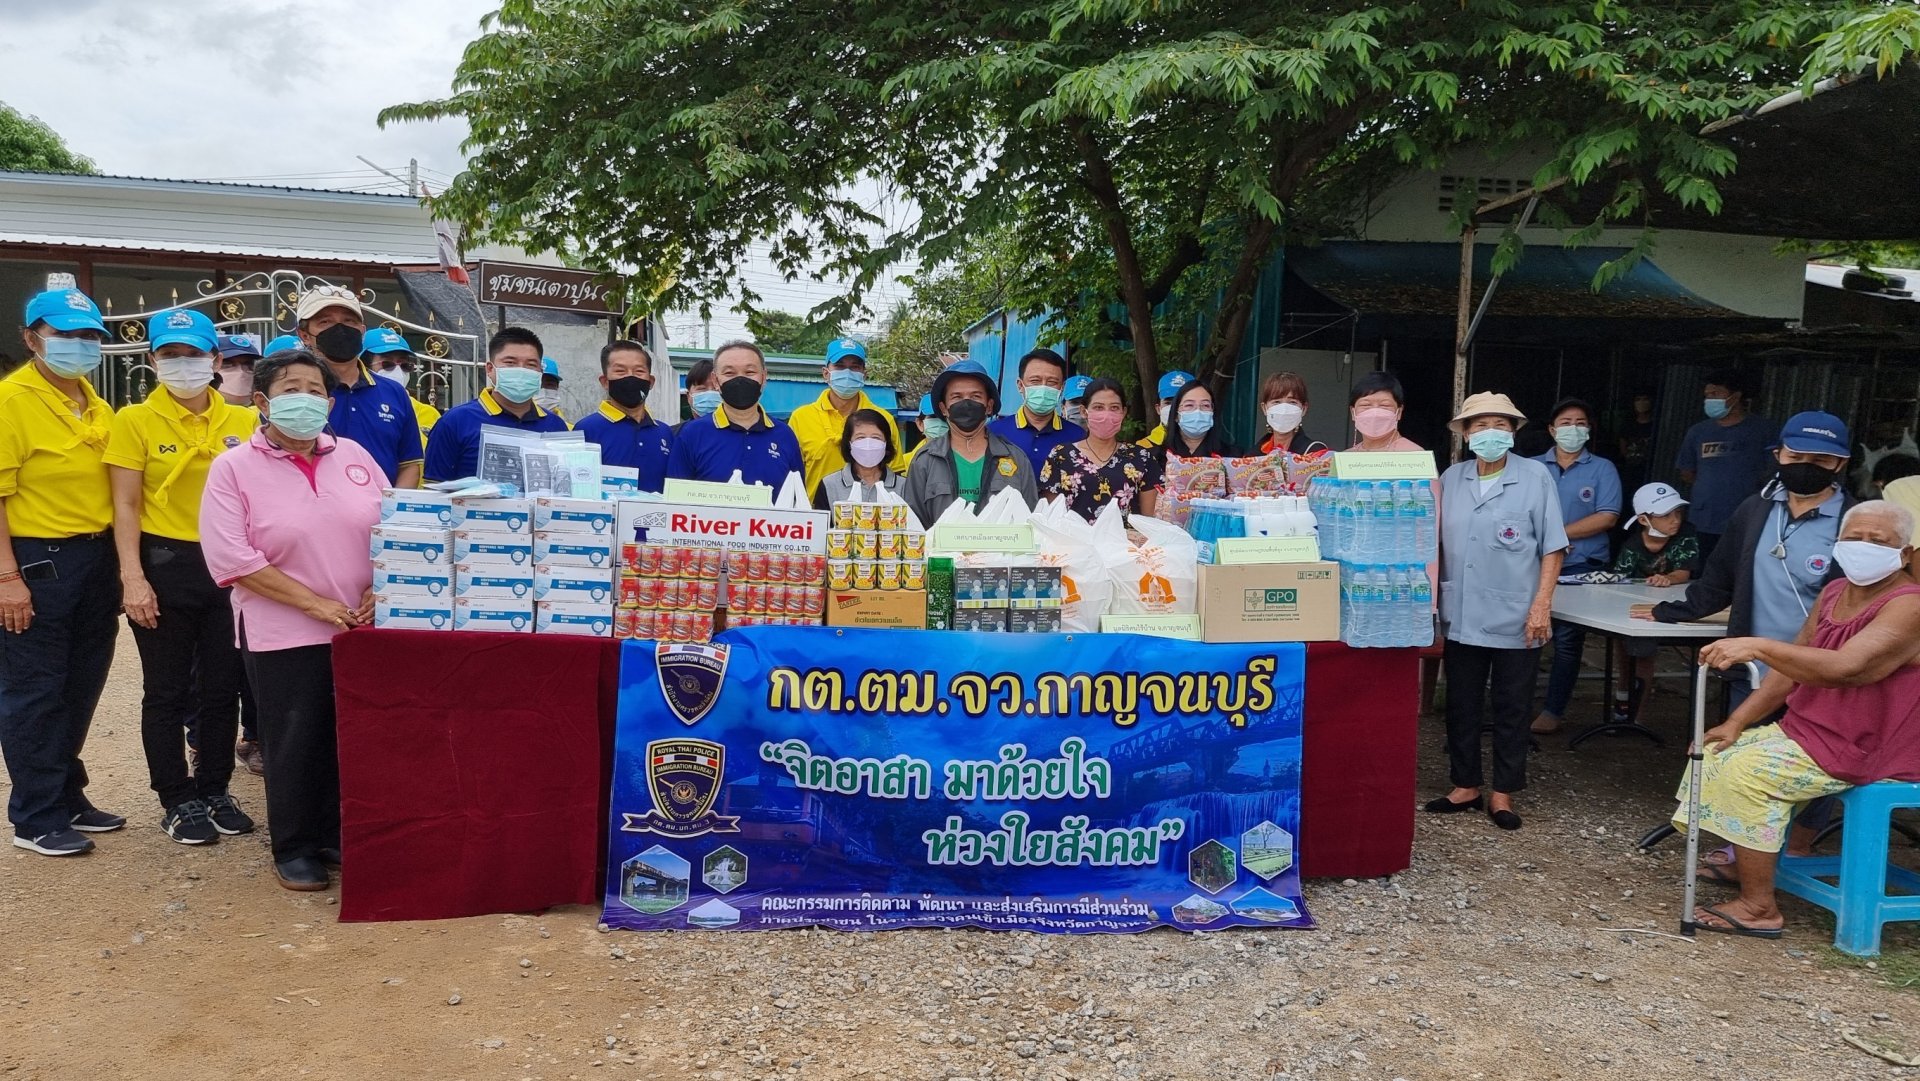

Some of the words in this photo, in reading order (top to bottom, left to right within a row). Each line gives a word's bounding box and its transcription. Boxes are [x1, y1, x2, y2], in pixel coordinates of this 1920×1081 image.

[489, 274, 603, 305] ชุมชนเตาปูน
[671, 513, 740, 536] River
[749, 519, 813, 540] Kwai
[672, 538, 724, 547] INTERNATIONAL
[749, 542, 781, 550] INDUSTRY
[1266, 591, 1294, 602] GPO
[660, 655, 698, 663] IMMIGRATION
[700, 657, 721, 671] BUREAU
[767, 657, 1276, 726] กต.ตม.จว.กาญจนบุรี
[657, 746, 676, 755] ROYAL
[693, 748, 715, 757] POLICE
[656, 764, 692, 773] IMMIGRATION
[693, 764, 714, 775] BUREAU
[760, 740, 929, 798] “จิตอาสา
[946, 737, 1110, 798] มาด้วยใจ
[924, 812, 1184, 865] ห่วงใยสังคม”
[762, 893, 910, 911] คณะกรรมการติดตาม
[918, 894, 964, 911] พัฒนา
[971, 896, 1149, 916] และส่งเสริมการมีส่วนร่วม
